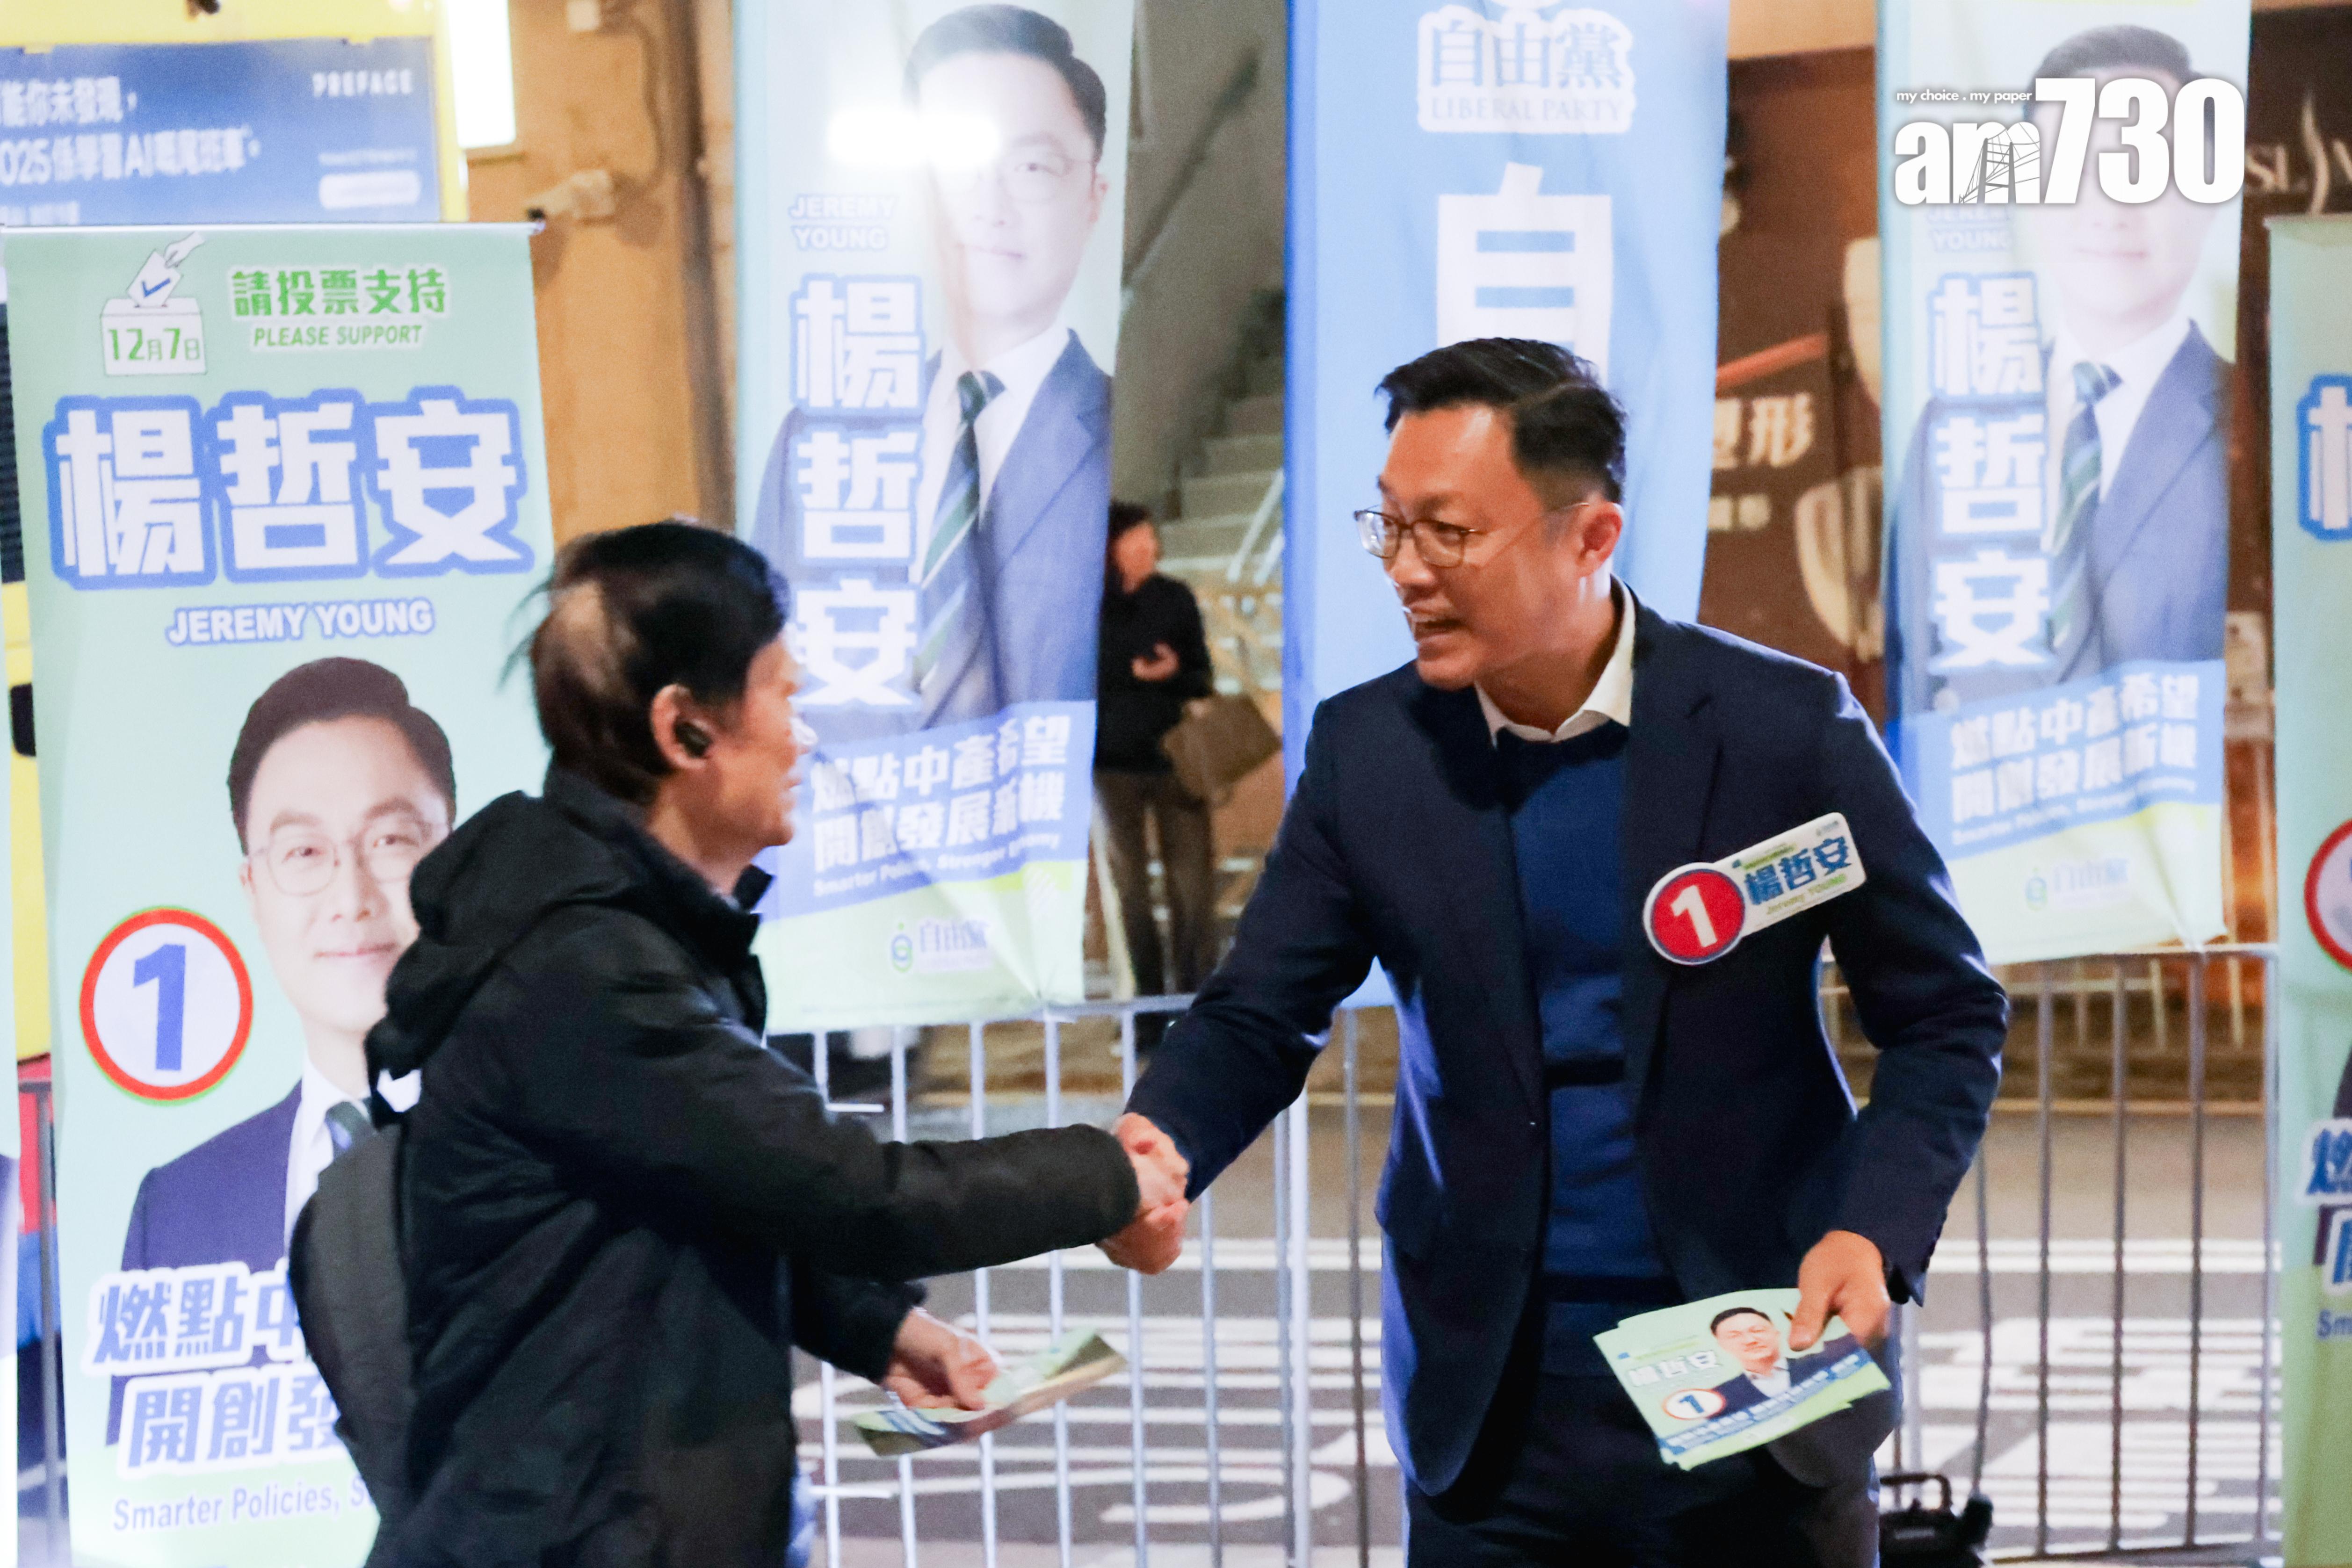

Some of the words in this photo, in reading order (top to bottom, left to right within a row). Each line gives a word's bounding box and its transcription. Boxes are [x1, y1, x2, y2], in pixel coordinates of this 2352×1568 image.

[1431, 19, 1622, 89] 自由黨
[312, 69, 413, 97] PREFACE
[1431, 96, 1538, 121] LIBERAL
[1543, 97, 1623, 122] PARTY
[790, 195, 896, 220] JEREMY
[795, 226, 887, 249] YOUNG
[232, 269, 445, 316] 請投票支持
[1437, 162, 1612, 383] 自
[109, 327, 200, 360] 12月7日
[253, 327, 329, 347] PLEASE
[336, 325, 422, 345] SUPPORT
[52, 397, 526, 580] 楊哲安
[788, 280, 920, 705] 楊哲安
[1930, 278, 2050, 668] 楊哲安
[169, 605, 309, 643] JEREMY
[316, 600, 434, 636] YOUNG
[1744, 835, 1852, 905] 楊哲安
[1671, 885, 1717, 948] 1
[133, 943, 186, 1071] 1
[1678, 1394, 1704, 1414] 1
[114, 1496, 222, 1531] Smarter
[233, 1482, 340, 1519] Policies,
